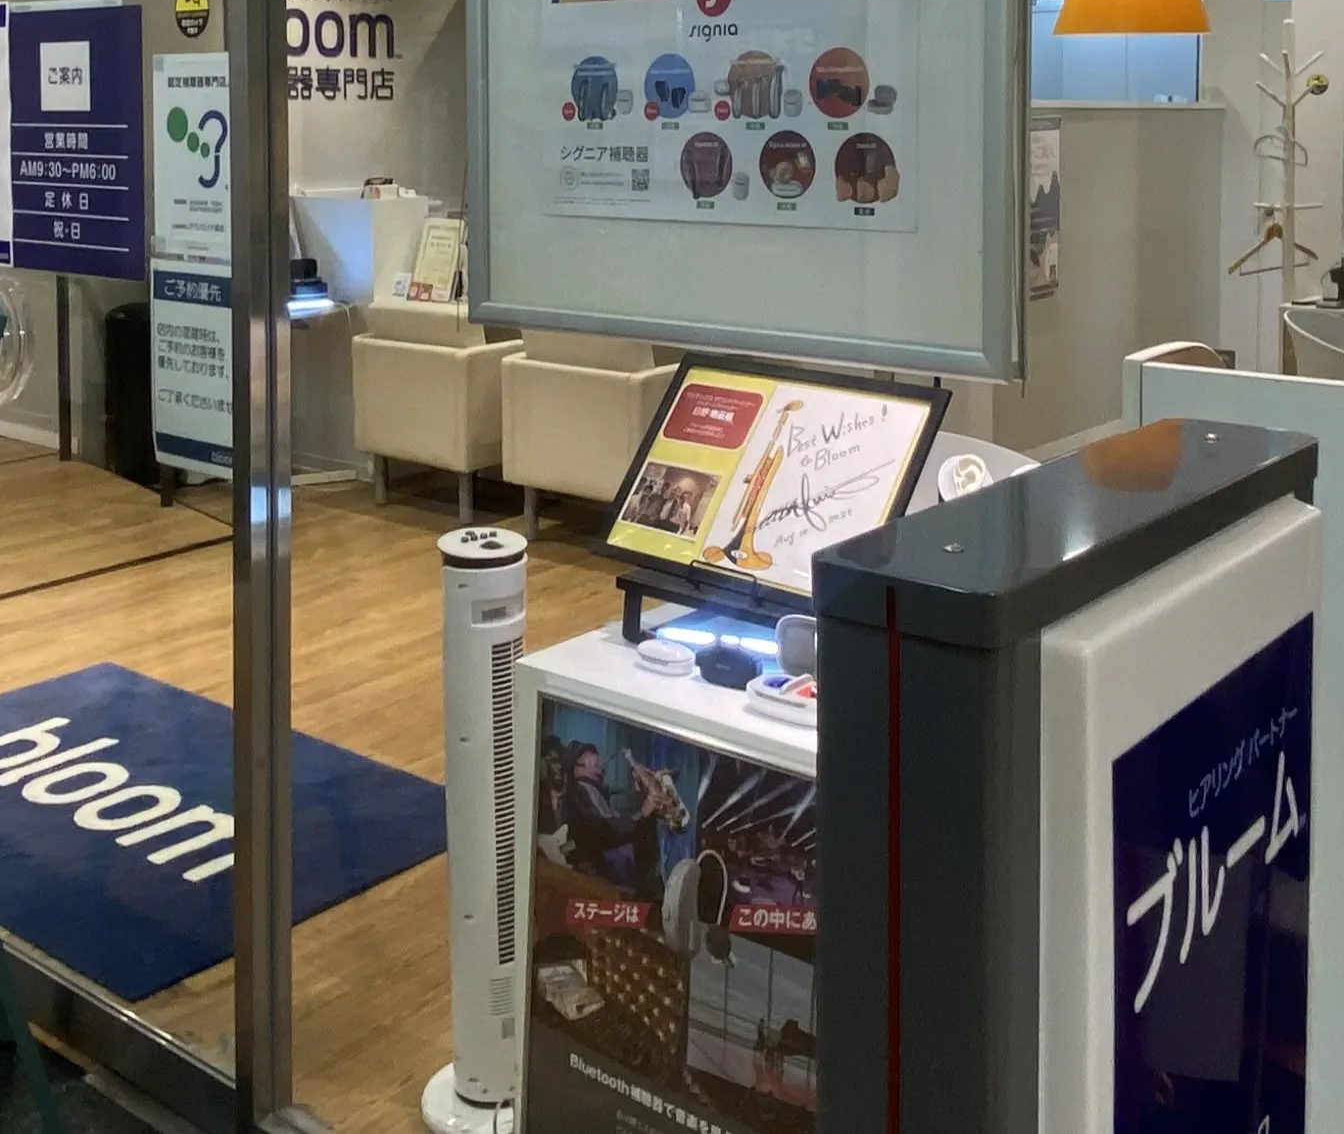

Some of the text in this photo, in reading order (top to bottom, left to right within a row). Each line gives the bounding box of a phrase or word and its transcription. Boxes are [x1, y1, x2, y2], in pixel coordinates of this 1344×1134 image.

[688, 22, 739, 43] signia
[47, 65, 84, 85] ご案内
[44, 131, 89, 151] 営業時間
[560, 145, 649, 163] シグニア補聴器
[164, 278, 223, 302] ご予約優先
[814, 444, 861, 472] Bloom
[1187, 706, 1298, 819] ヒアリング パートナー
[1126, 751, 1307, 1014] ブルーム
[573, 900, 640, 924] ステージは
